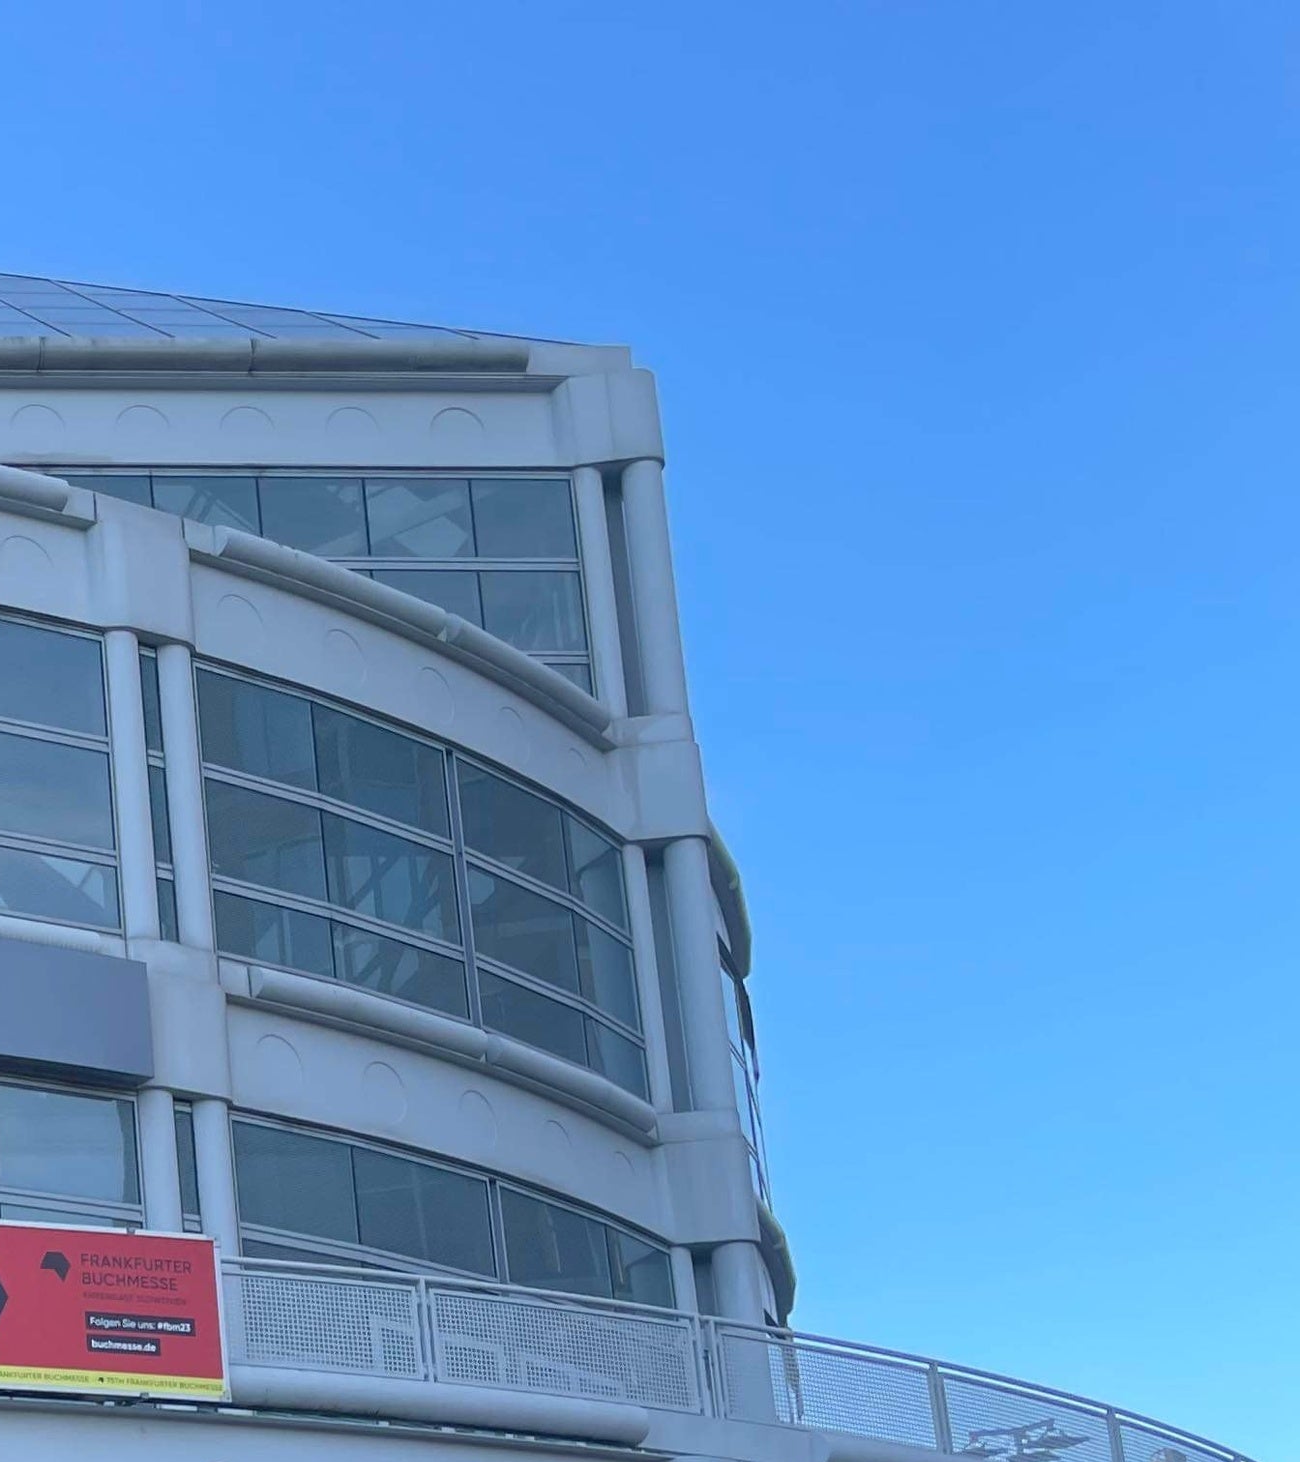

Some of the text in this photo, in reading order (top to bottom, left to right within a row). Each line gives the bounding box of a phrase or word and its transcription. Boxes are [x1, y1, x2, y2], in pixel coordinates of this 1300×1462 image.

[81, 1254, 191, 1273] FRANKFURTER
[82, 1272, 177, 1290] BUCHMESSE
[90, 1317, 120, 1329] Folgen
[122, 1319, 136, 1328] Sie
[158, 1323, 191, 1332] #fbm23
[92, 1339, 156, 1352] buchmesse.de
